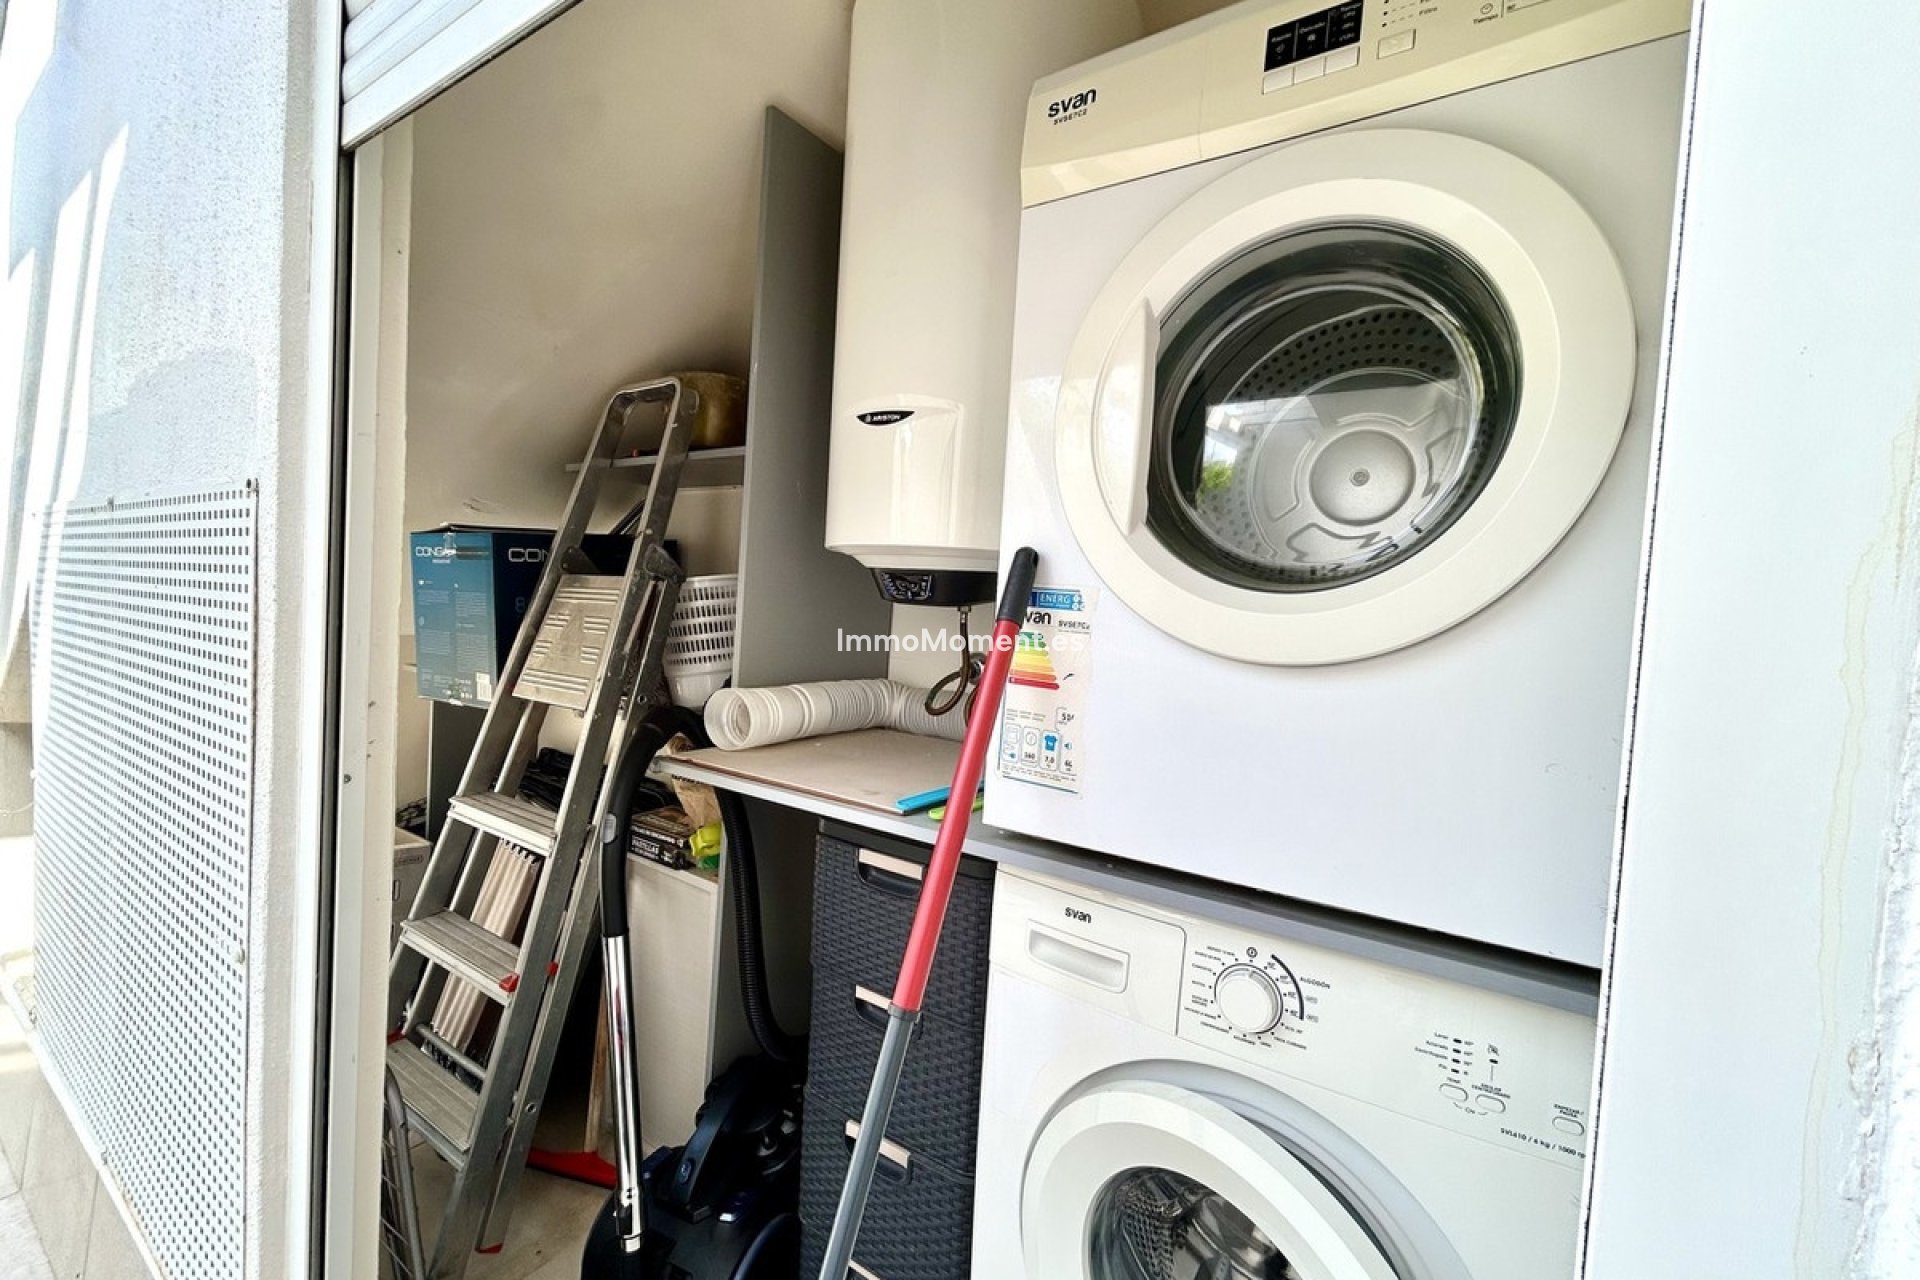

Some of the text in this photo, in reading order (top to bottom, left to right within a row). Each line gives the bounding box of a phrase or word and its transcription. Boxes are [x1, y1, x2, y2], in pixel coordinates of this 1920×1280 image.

[1048, 88, 1097, 118] svan
[1064, 906, 1092, 924] svan
[1540, 1140, 1551, 1149] kg
[1558, 1145, 1577, 1156] 1000
